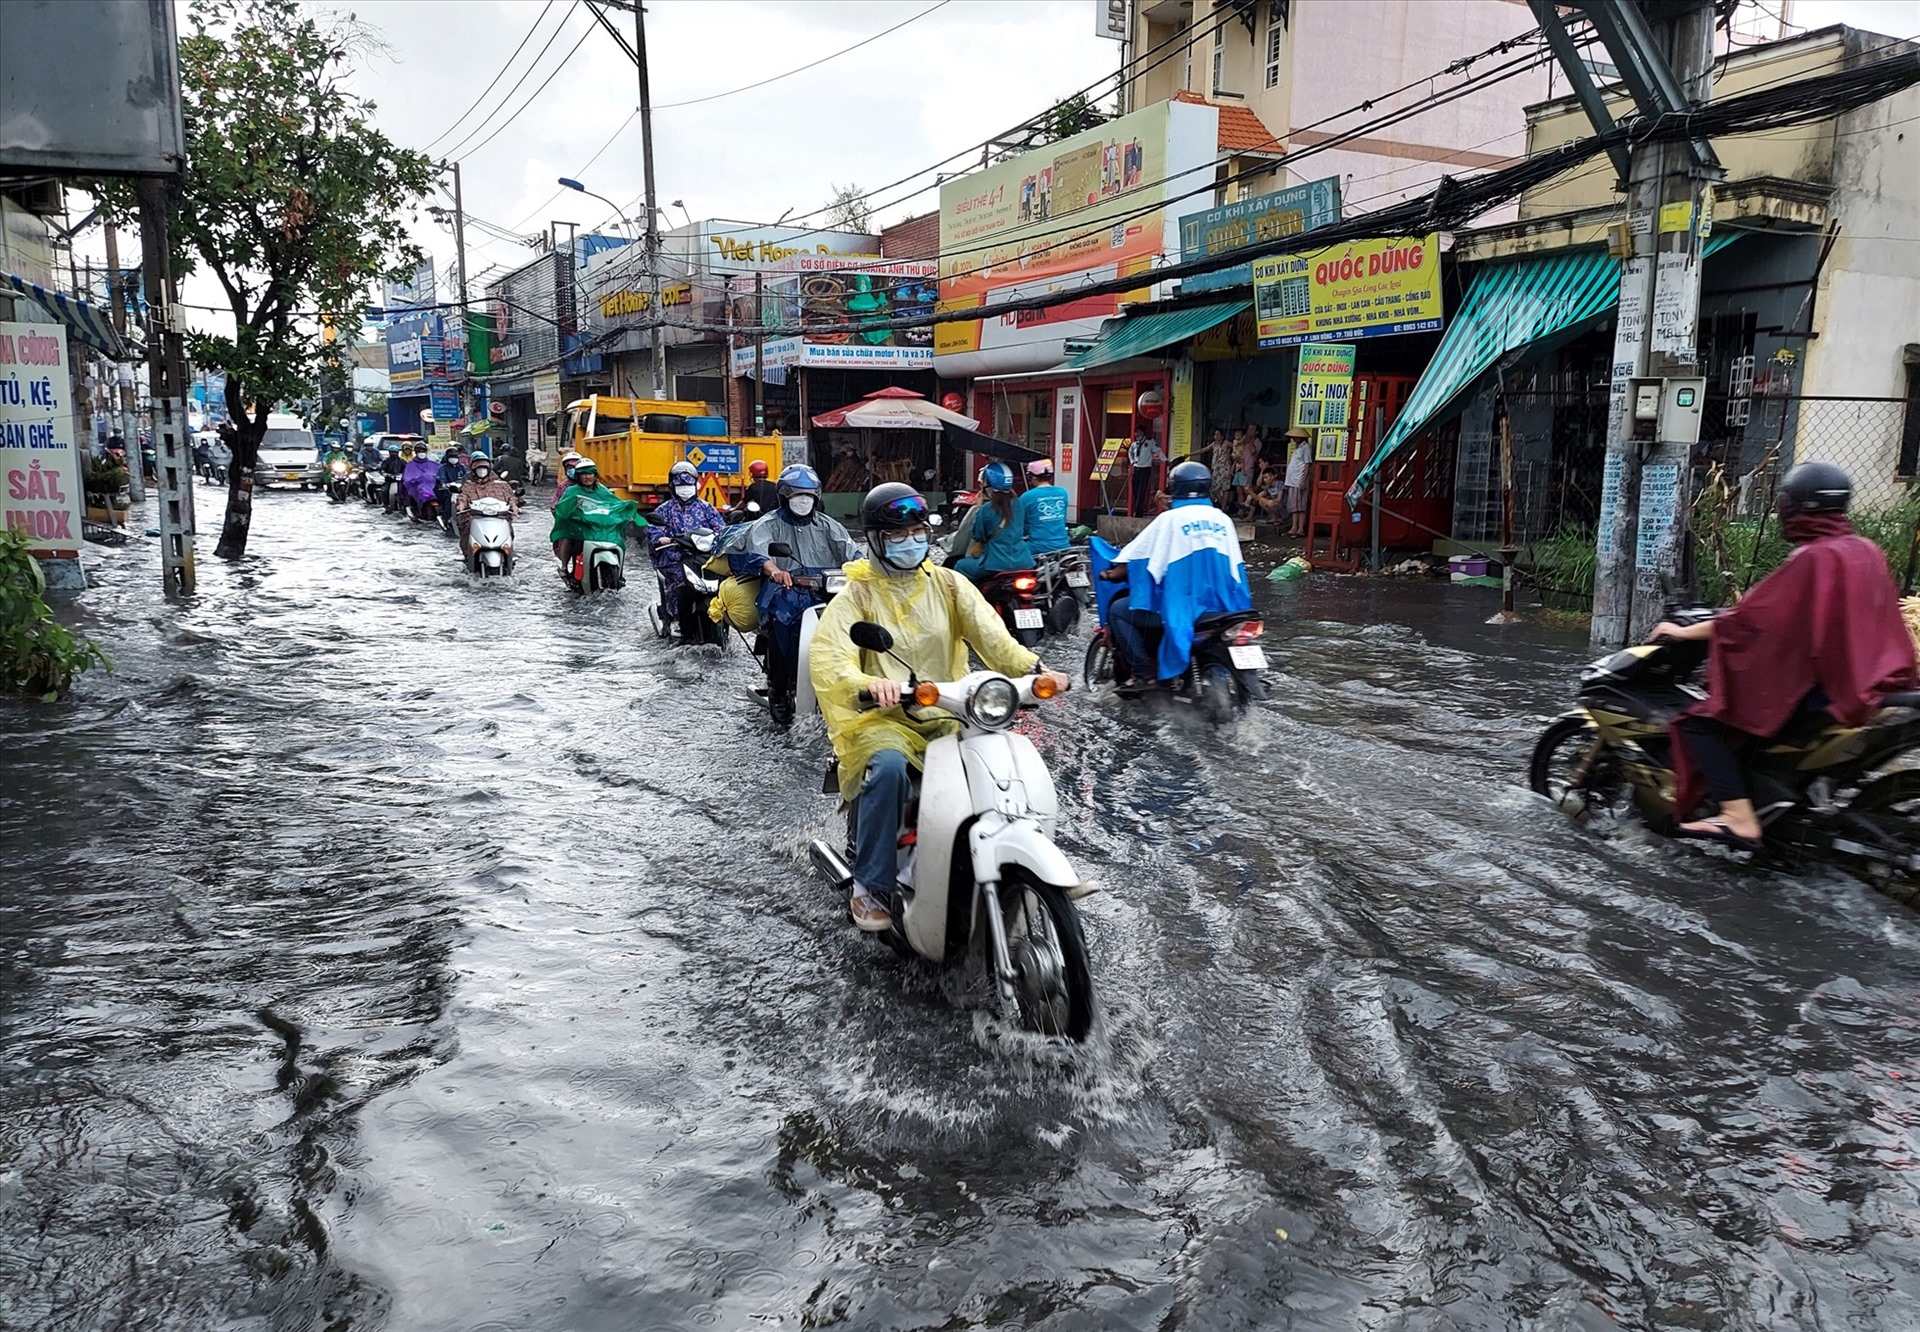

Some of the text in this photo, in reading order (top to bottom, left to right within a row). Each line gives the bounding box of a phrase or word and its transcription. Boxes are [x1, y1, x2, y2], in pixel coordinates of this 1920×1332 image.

[1206, 189, 1307, 223] CƠ KHÍ XÂY DỰNG
[711, 236, 755, 262] Viet
[800, 258, 812, 269] CƠ
[814, 258, 825, 270] SỞ
[906, 262, 920, 275] THỦ
[1255, 267, 1264, 278] CƠ
[1315, 245, 1423, 287] QUỐC DŨNG
[18, 329, 61, 367] CÔNG
[809, 348, 825, 356] Mua
[827, 347, 841, 356] bán
[919, 350, 925, 358] 3
[1302, 359, 1325, 372] QUỐC
[30, 376, 58, 411] KỆ,
[1300, 377, 1349, 399] SẮT INOX
[0, 422, 25, 449] BÀN
[8, 458, 65, 504] SẮT,
[6, 510, 73, 541] INOX
